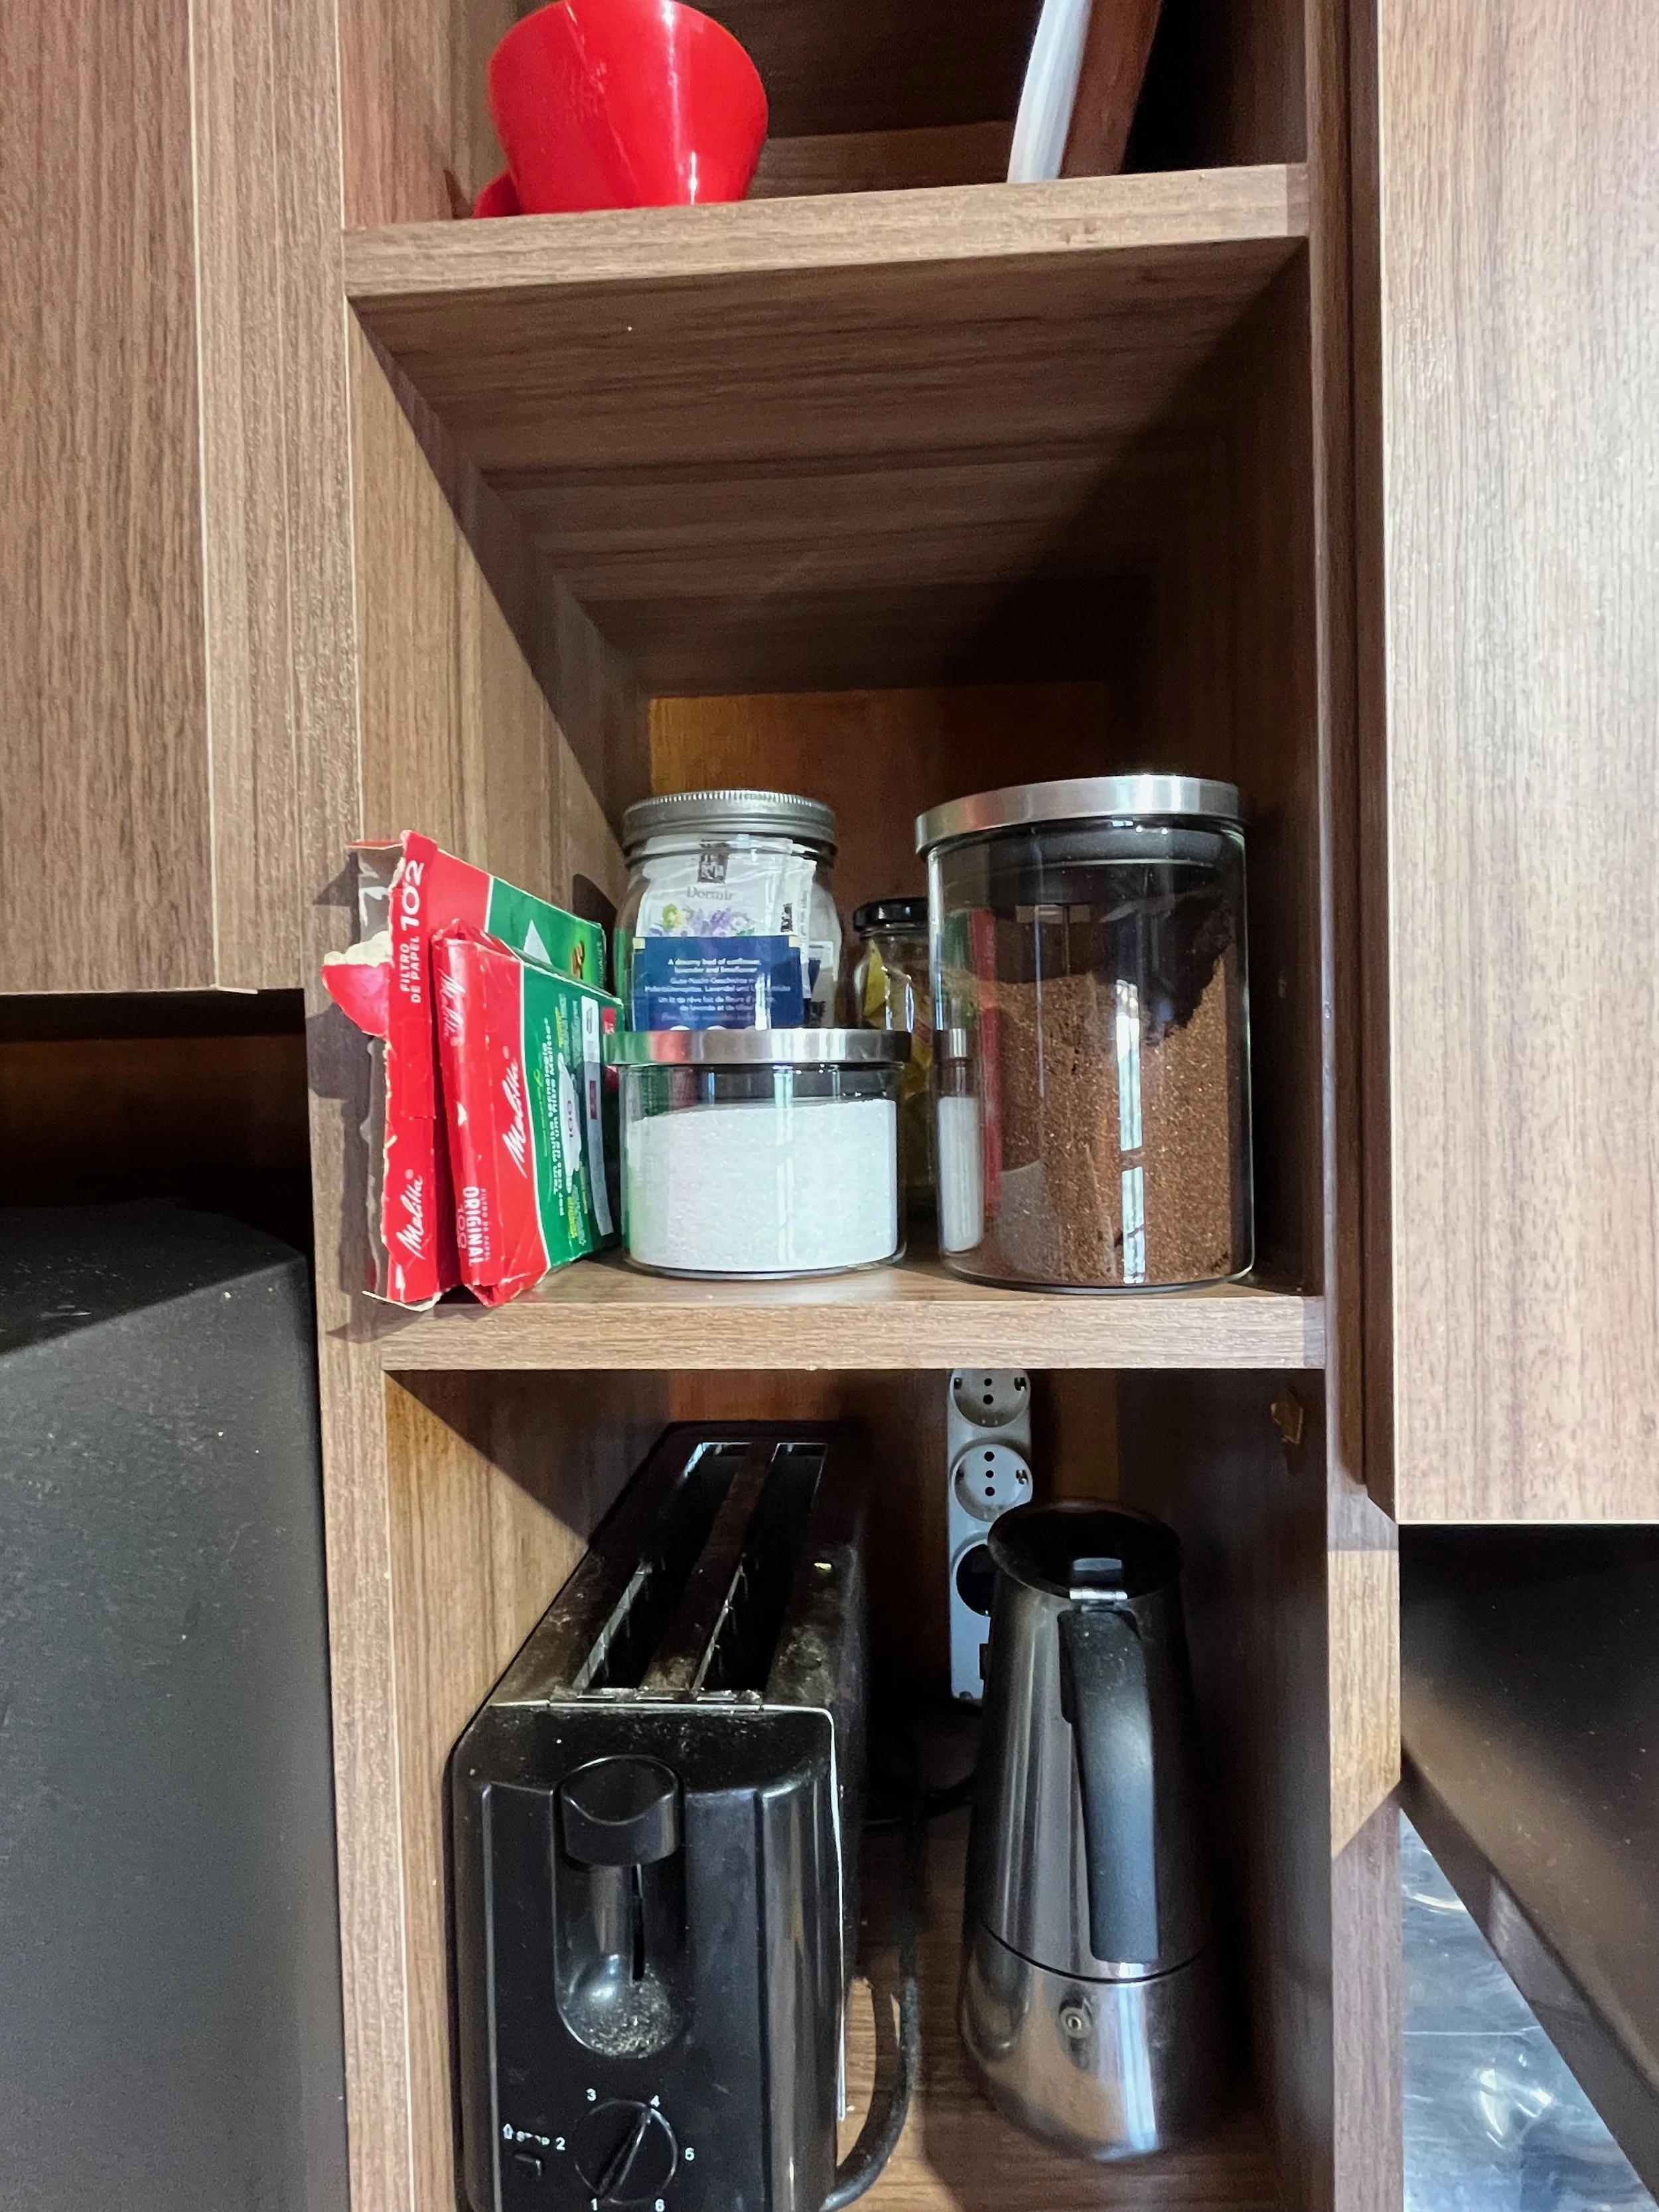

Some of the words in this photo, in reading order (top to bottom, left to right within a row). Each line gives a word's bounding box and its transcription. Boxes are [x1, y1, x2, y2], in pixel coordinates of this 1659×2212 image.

[400, 860, 424, 931] 102
[400, 943, 409, 992] FILTRO
[410, 936, 419, 980] PAPEL
[411, 986, 421, 1003] DE
[502, 1059, 528, 1179] Melitta
[396, 1175, 425, 1260] Melitta
[464, 1186, 484, 1266] ORIGINAL
[587, 2089, 597, 2101] 3
[650, 2095, 660, 2107] 4
[555, 2137, 565, 2150] 2
[591, 2198, 597, 2211] 1
